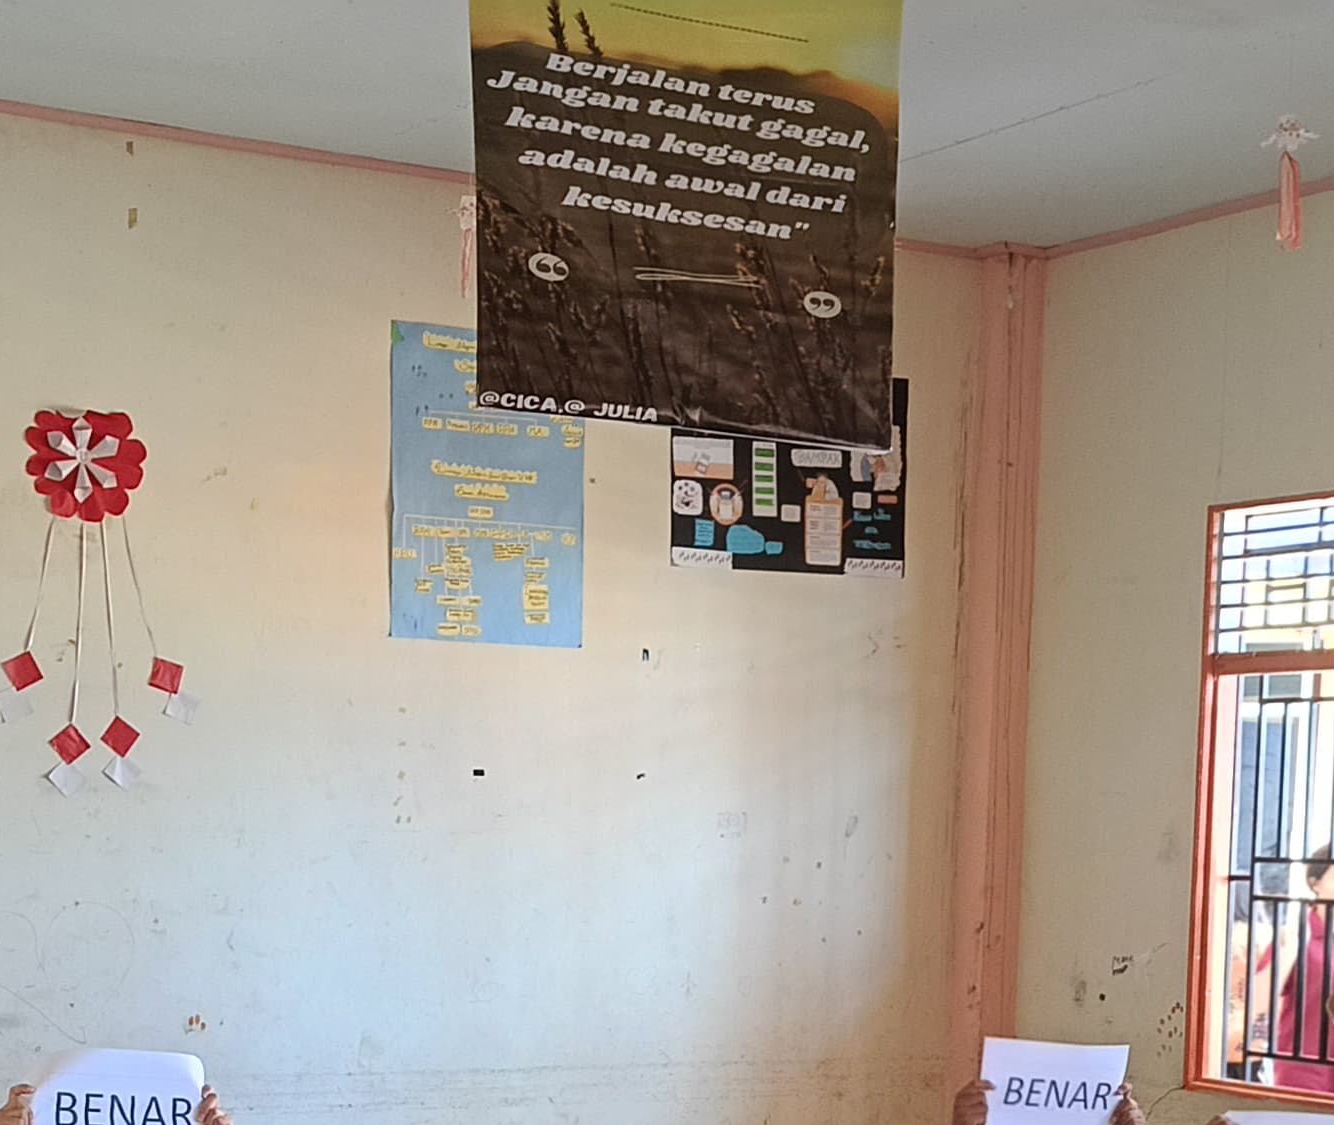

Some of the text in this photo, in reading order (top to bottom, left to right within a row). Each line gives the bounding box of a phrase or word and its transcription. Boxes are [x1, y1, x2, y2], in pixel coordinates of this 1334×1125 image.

[486, 70, 870, 154] Jangan takut gagal,
[545, 53, 815, 115] Berjalan terus
[504, 106, 857, 182] karena kegagalan
[518, 147, 848, 214] adalah awal dari
[594, 402, 658, 422] JULIA
[1003, 1077, 1112, 1110] BENAR
